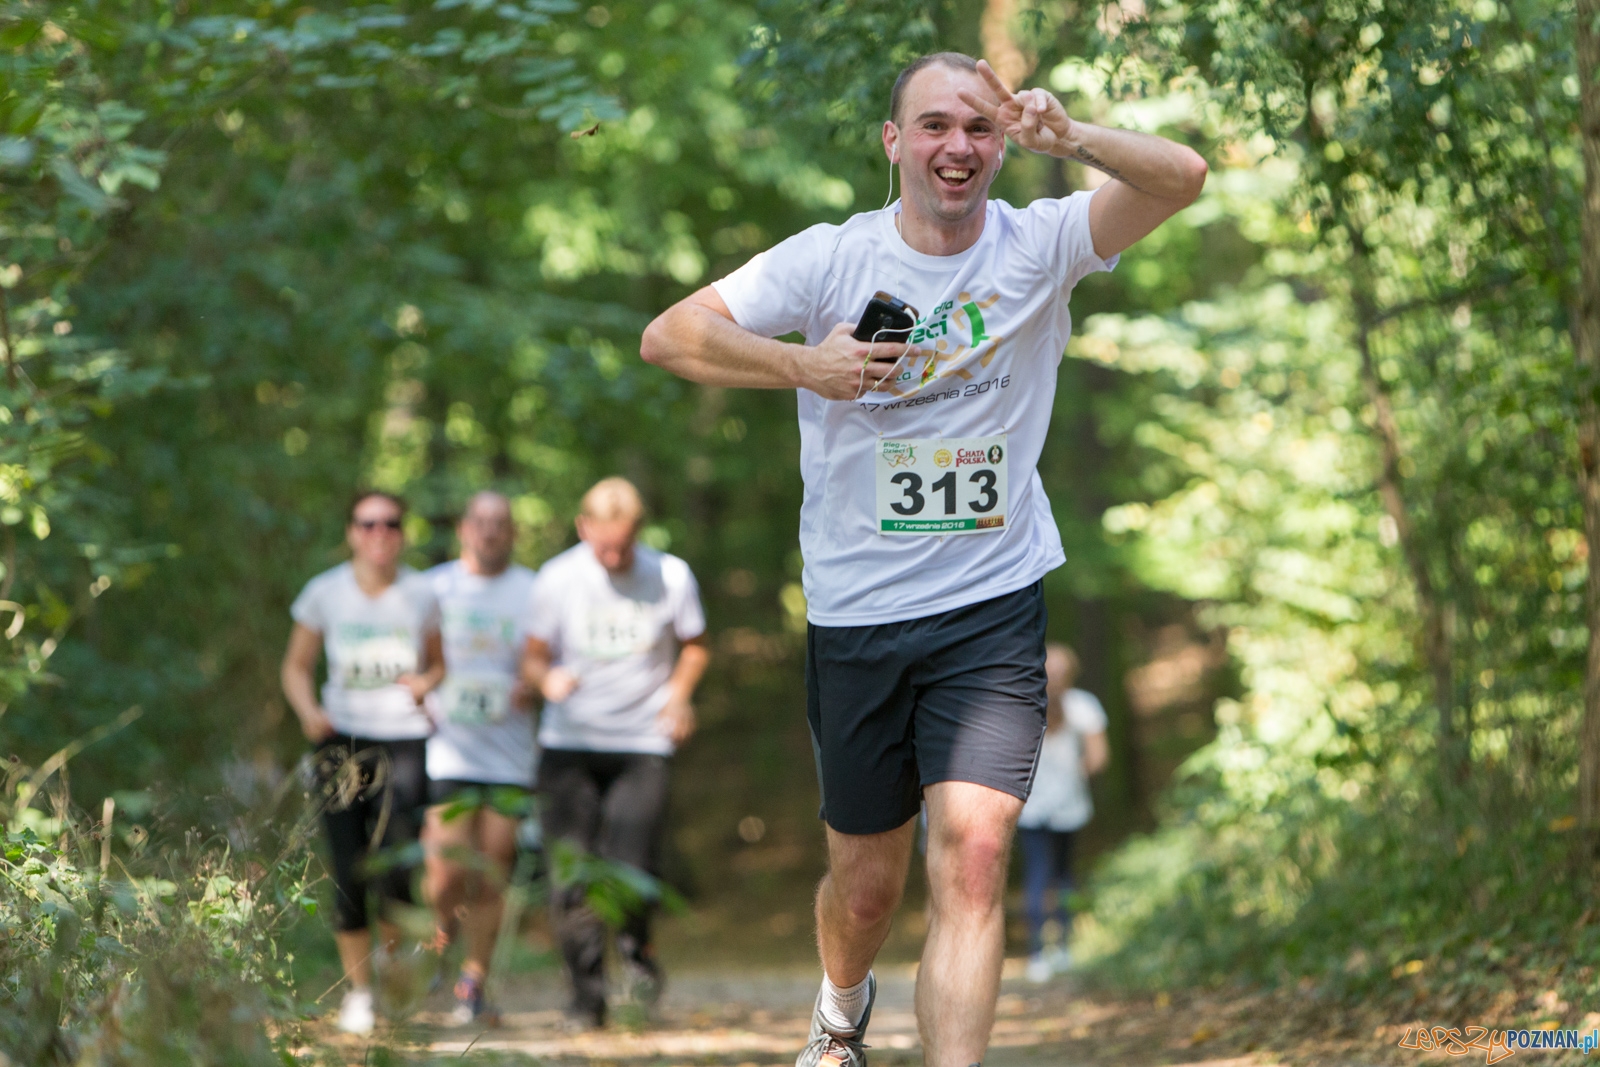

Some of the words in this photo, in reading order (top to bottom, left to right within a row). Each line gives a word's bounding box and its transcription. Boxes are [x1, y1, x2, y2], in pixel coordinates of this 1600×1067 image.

[860, 402, 880, 412] 17
[883, 388, 960, 411] września
[963, 374, 1011, 397] 2016
[957, 448, 985, 458] CHATA
[955, 457, 987, 467] POLSKA
[890, 469, 998, 515] 313
[893, 522, 905, 530] 17
